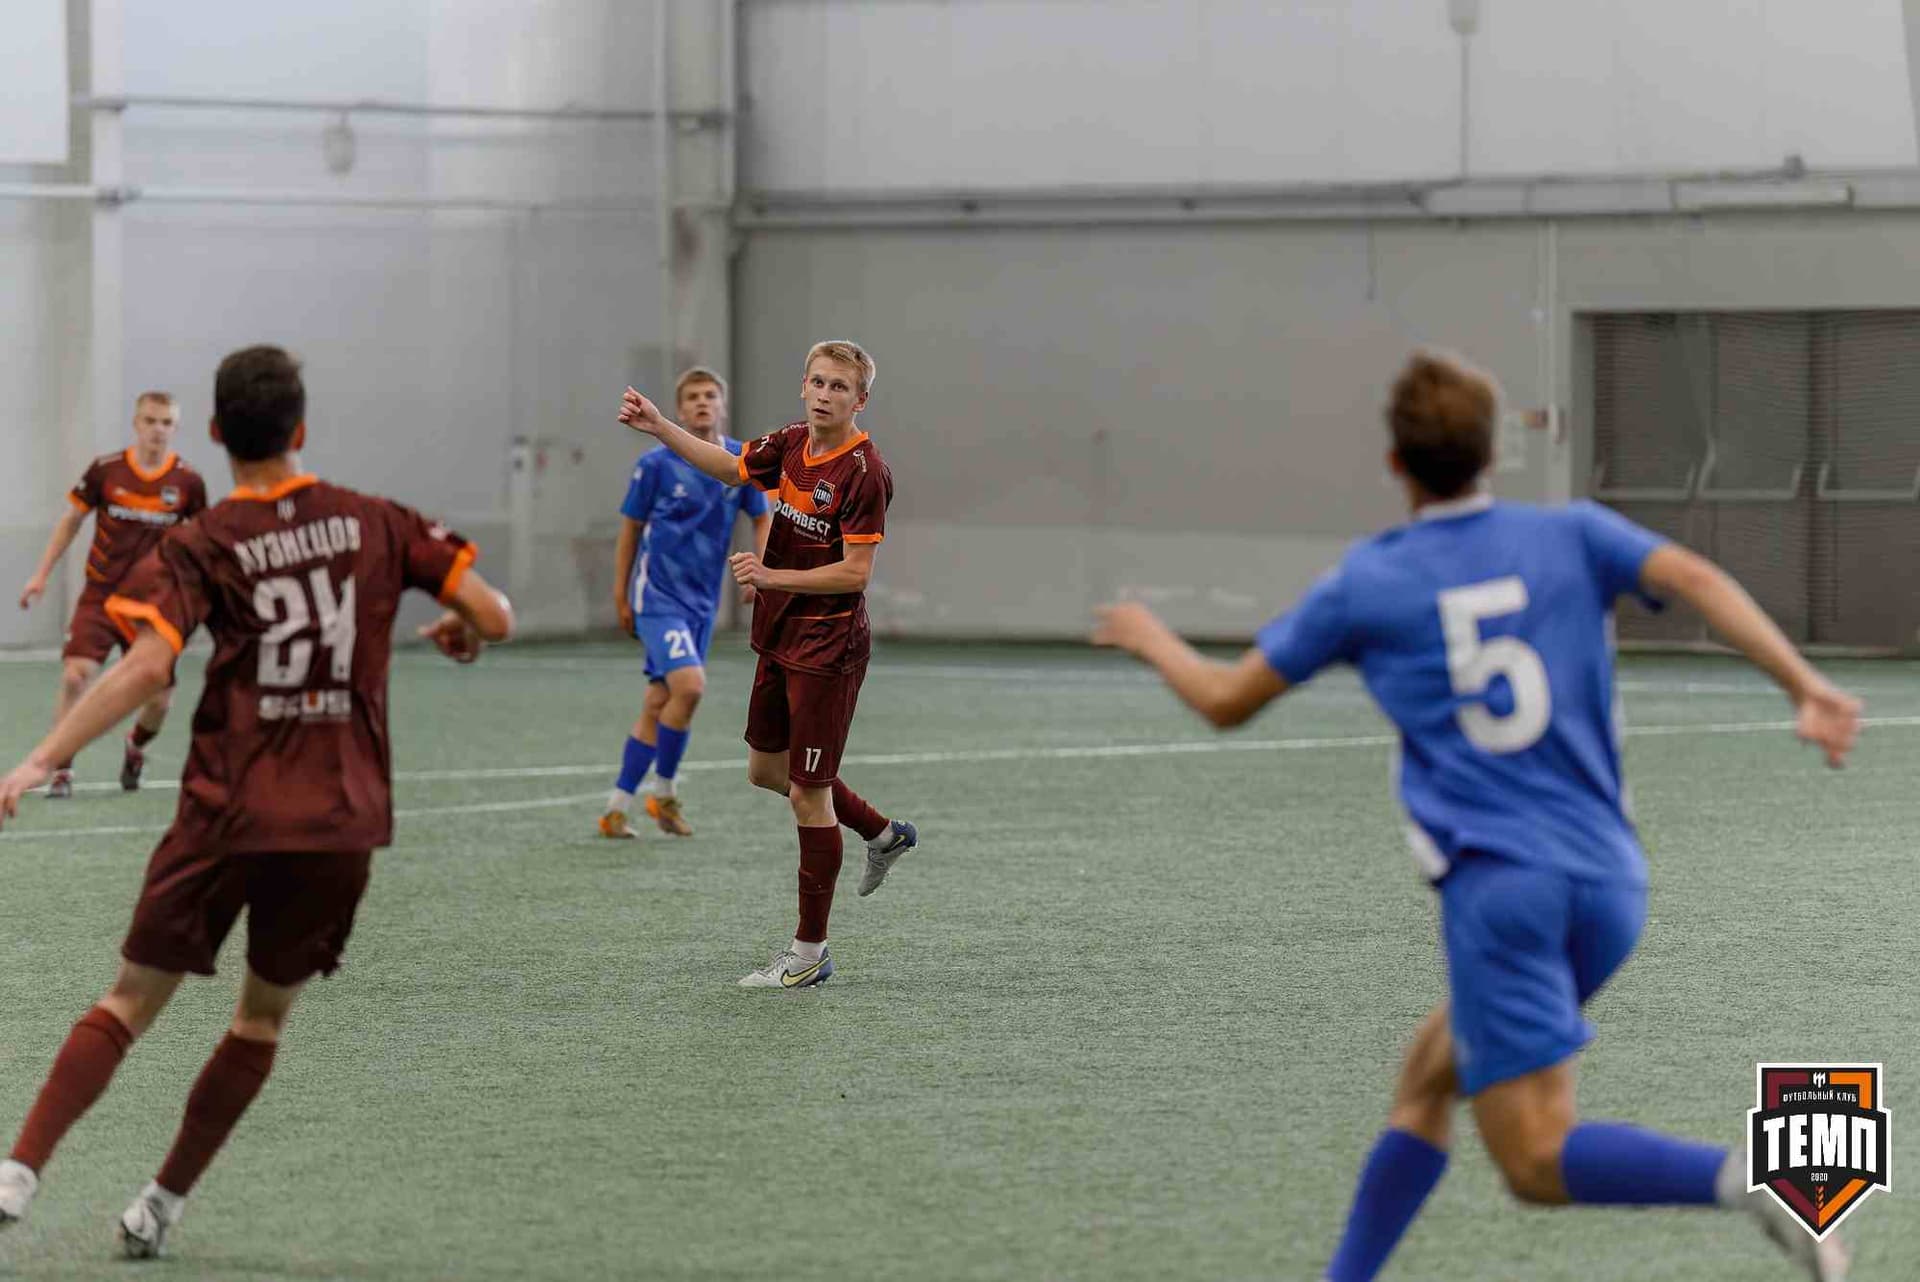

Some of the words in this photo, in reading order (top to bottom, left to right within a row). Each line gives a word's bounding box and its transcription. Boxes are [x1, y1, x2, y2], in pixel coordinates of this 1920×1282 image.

[253, 566, 358, 688] 24
[664, 629, 698, 660] 21
[1437, 575, 1553, 755] 5
[805, 747, 822, 773] 17
